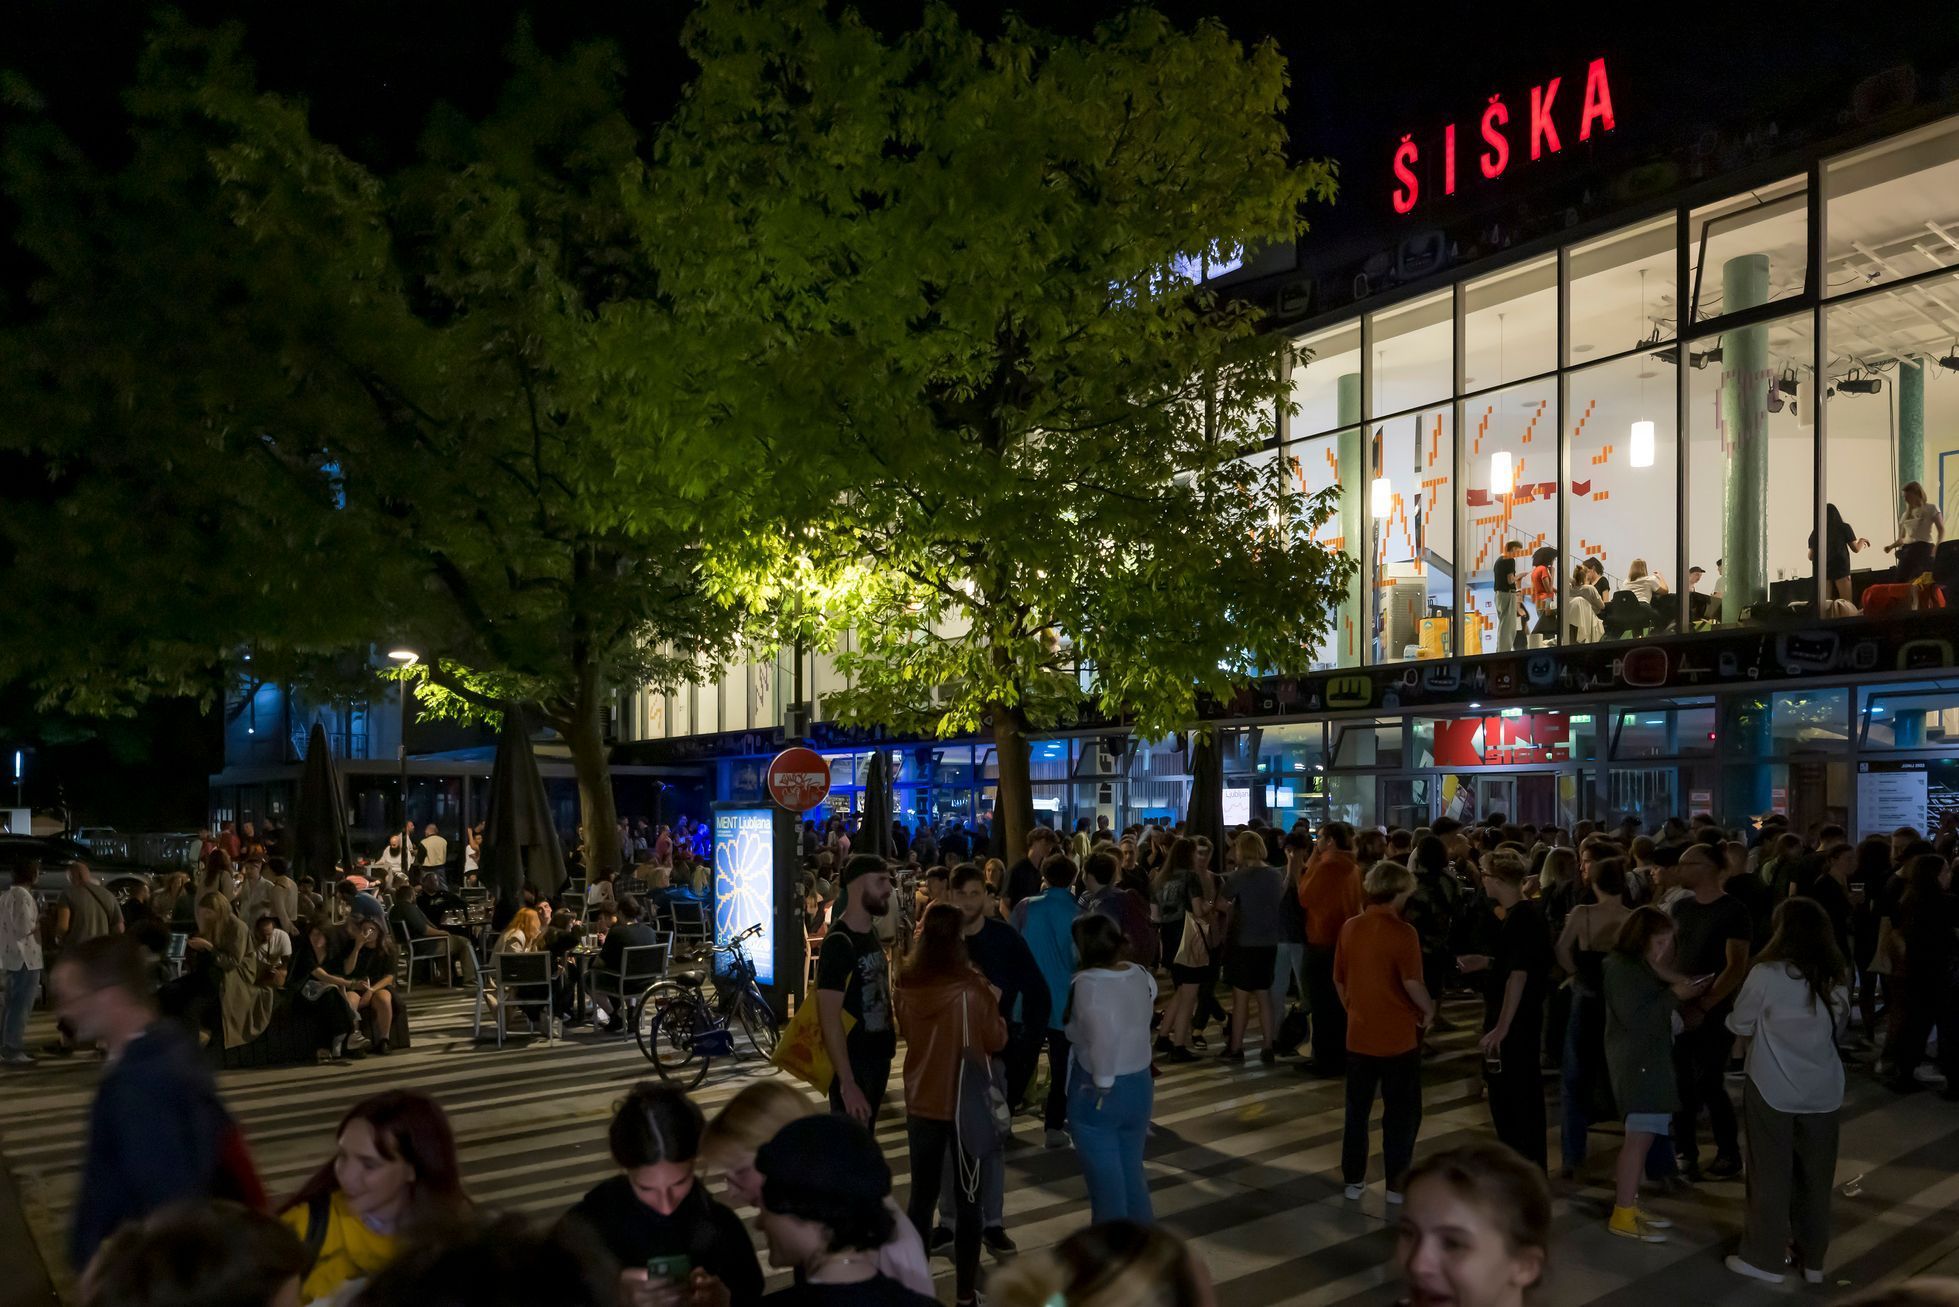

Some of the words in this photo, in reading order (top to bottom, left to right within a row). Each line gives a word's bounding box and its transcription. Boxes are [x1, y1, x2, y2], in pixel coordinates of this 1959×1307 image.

[1393, 57, 1616, 214] ŠIŠKA
[716, 816, 737, 829] MENT
[738, 816, 770, 831] Ljubljana
